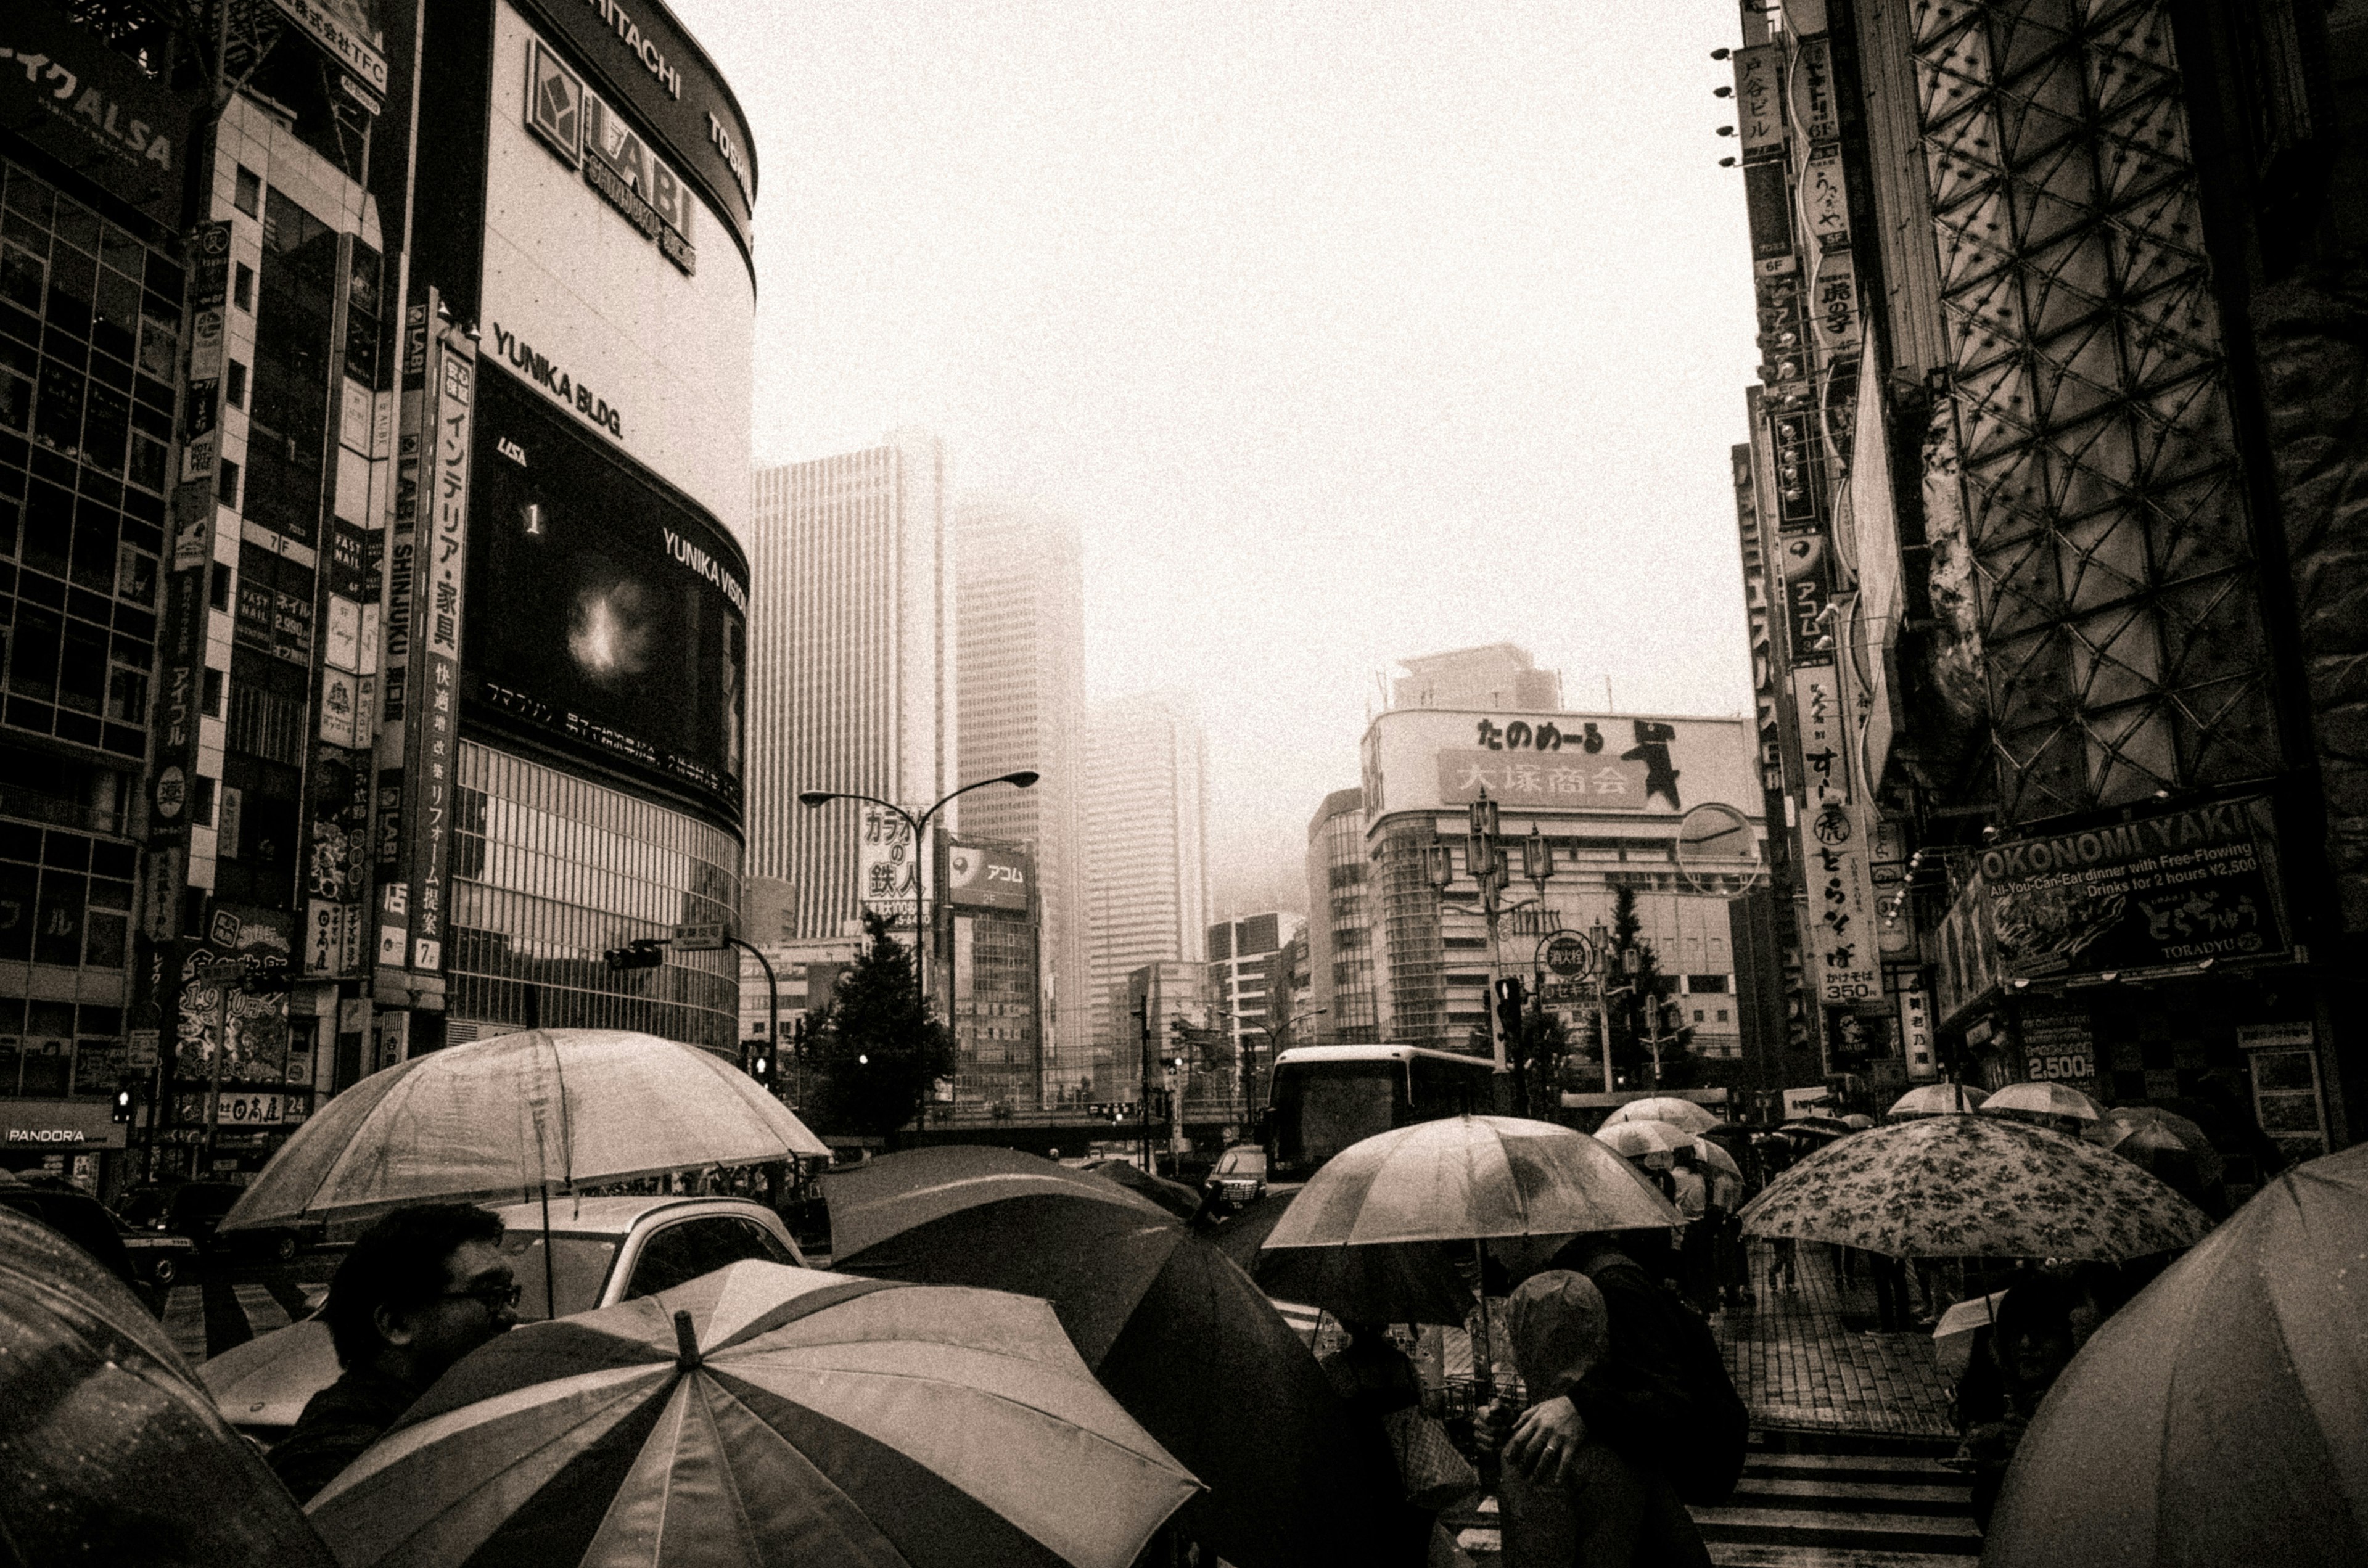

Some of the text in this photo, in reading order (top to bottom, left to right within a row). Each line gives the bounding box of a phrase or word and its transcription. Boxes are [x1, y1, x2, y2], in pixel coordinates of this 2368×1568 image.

[286, 0, 383, 83] 株式会社TFC
[0, 47, 77, 99] イク
[74, 87, 171, 171] ALSA
[590, 92, 691, 245] LABI
[589, 155, 660, 239] SHINJUKU
[1768, 261, 1783, 273] 6F
[411, 329, 427, 374] LABI
[493, 321, 573, 399] YUNIKA
[575, 384, 623, 440] BLDG.
[435, 414, 466, 651] インテリア・家具
[526, 503, 540, 535] 1
[335, 533, 361, 551] FAST
[664, 527, 720, 587] YUNIKA
[242, 589, 269, 607] FAST
[384, 457, 418, 723] LABI SHINJUKU 東口館
[1797, 581, 1821, 636] アコム
[167, 667, 189, 747] アイフル
[1478, 718, 1604, 753] たのめーる
[1457, 763, 1627, 795] 大塚商会
[383, 812, 400, 863] LABI
[891, 844, 905, 863] の
[1983, 803, 2247, 878] OKONOMI YAKI
[870, 863, 925, 897] 鉄人
[987, 864, 1024, 884] アコム
[1990, 842, 2253, 898] All-You-Can-Eat dinner with Free-Flowing
[2087, 856, 2258, 898] Drinks for 2 hours ¥2,500
[1548, 950, 1584, 964] 消火栓
[2161, 938, 2236, 959] TORADYU
[1827, 971, 1873, 983] かけそば
[1827, 985, 1877, 999] 350円
[2029, 1055, 2095, 1080] 2,500円
[288, 1097, 304, 1114] 24
[9, 1130, 84, 1142] PANDORA
